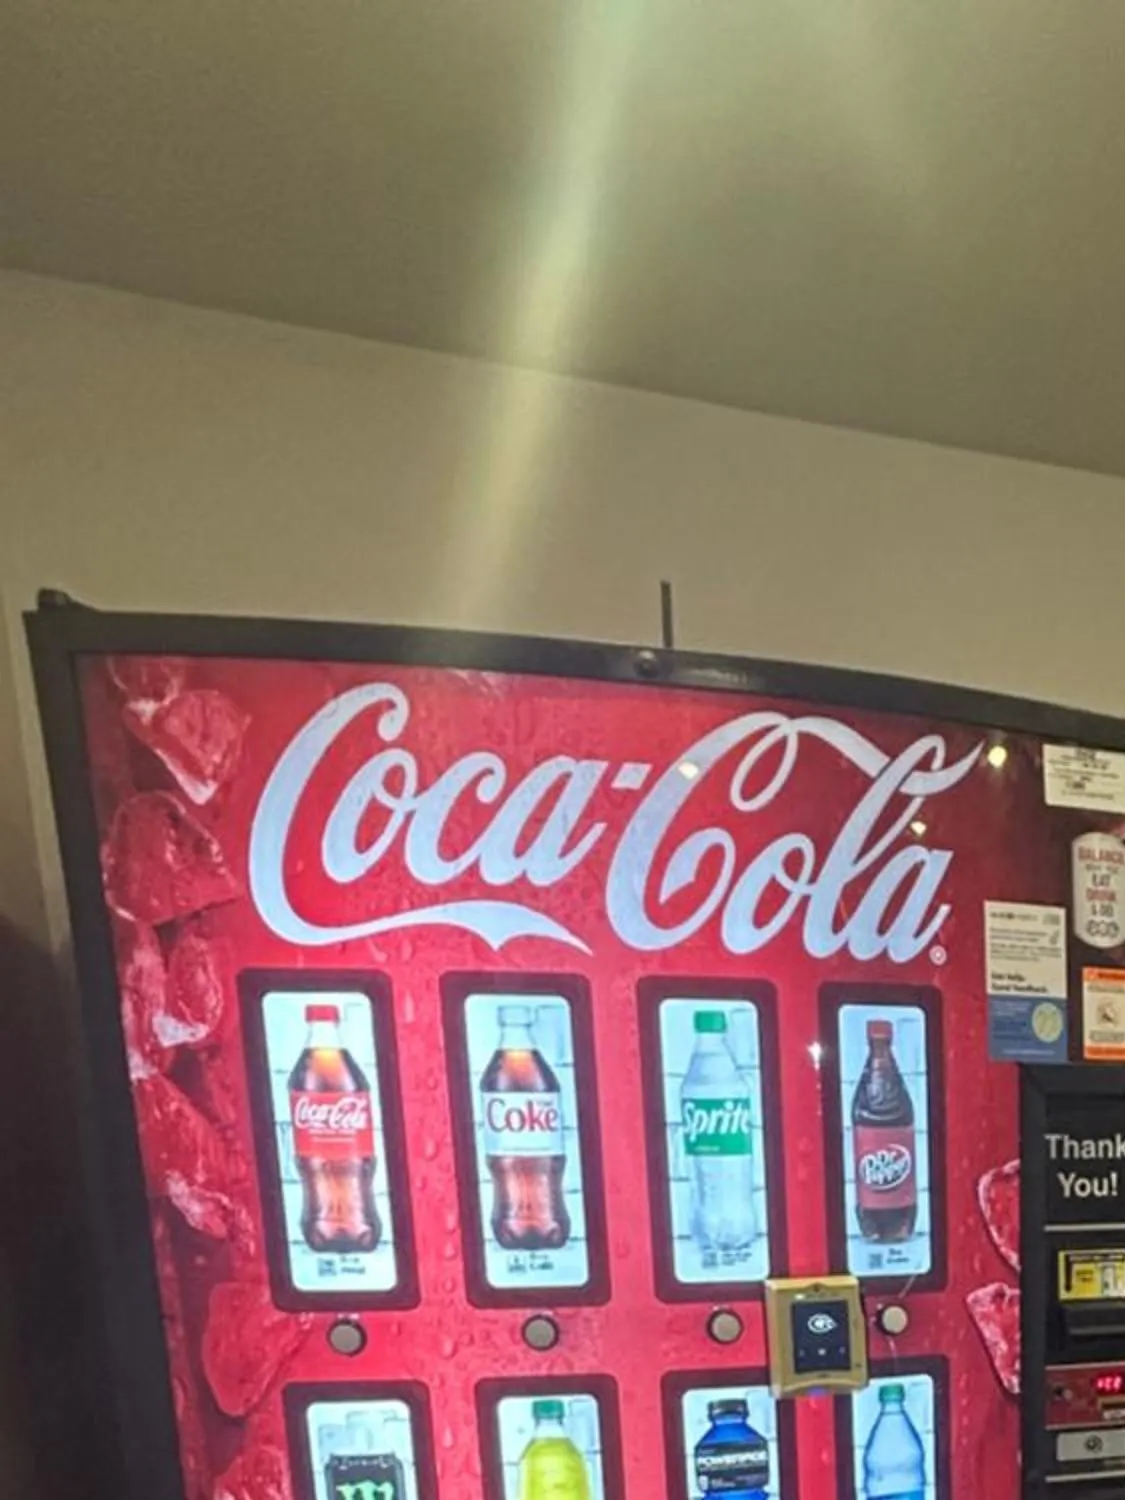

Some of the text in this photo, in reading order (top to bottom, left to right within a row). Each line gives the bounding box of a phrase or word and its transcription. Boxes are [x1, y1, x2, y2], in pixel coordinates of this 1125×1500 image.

[249, 682, 982, 964] Coca-Cola
[295, 1096, 367, 1130] Coca-Cola
[487, 1098, 559, 1133] Coke
[1057, 1171, 1118, 1198] You!
